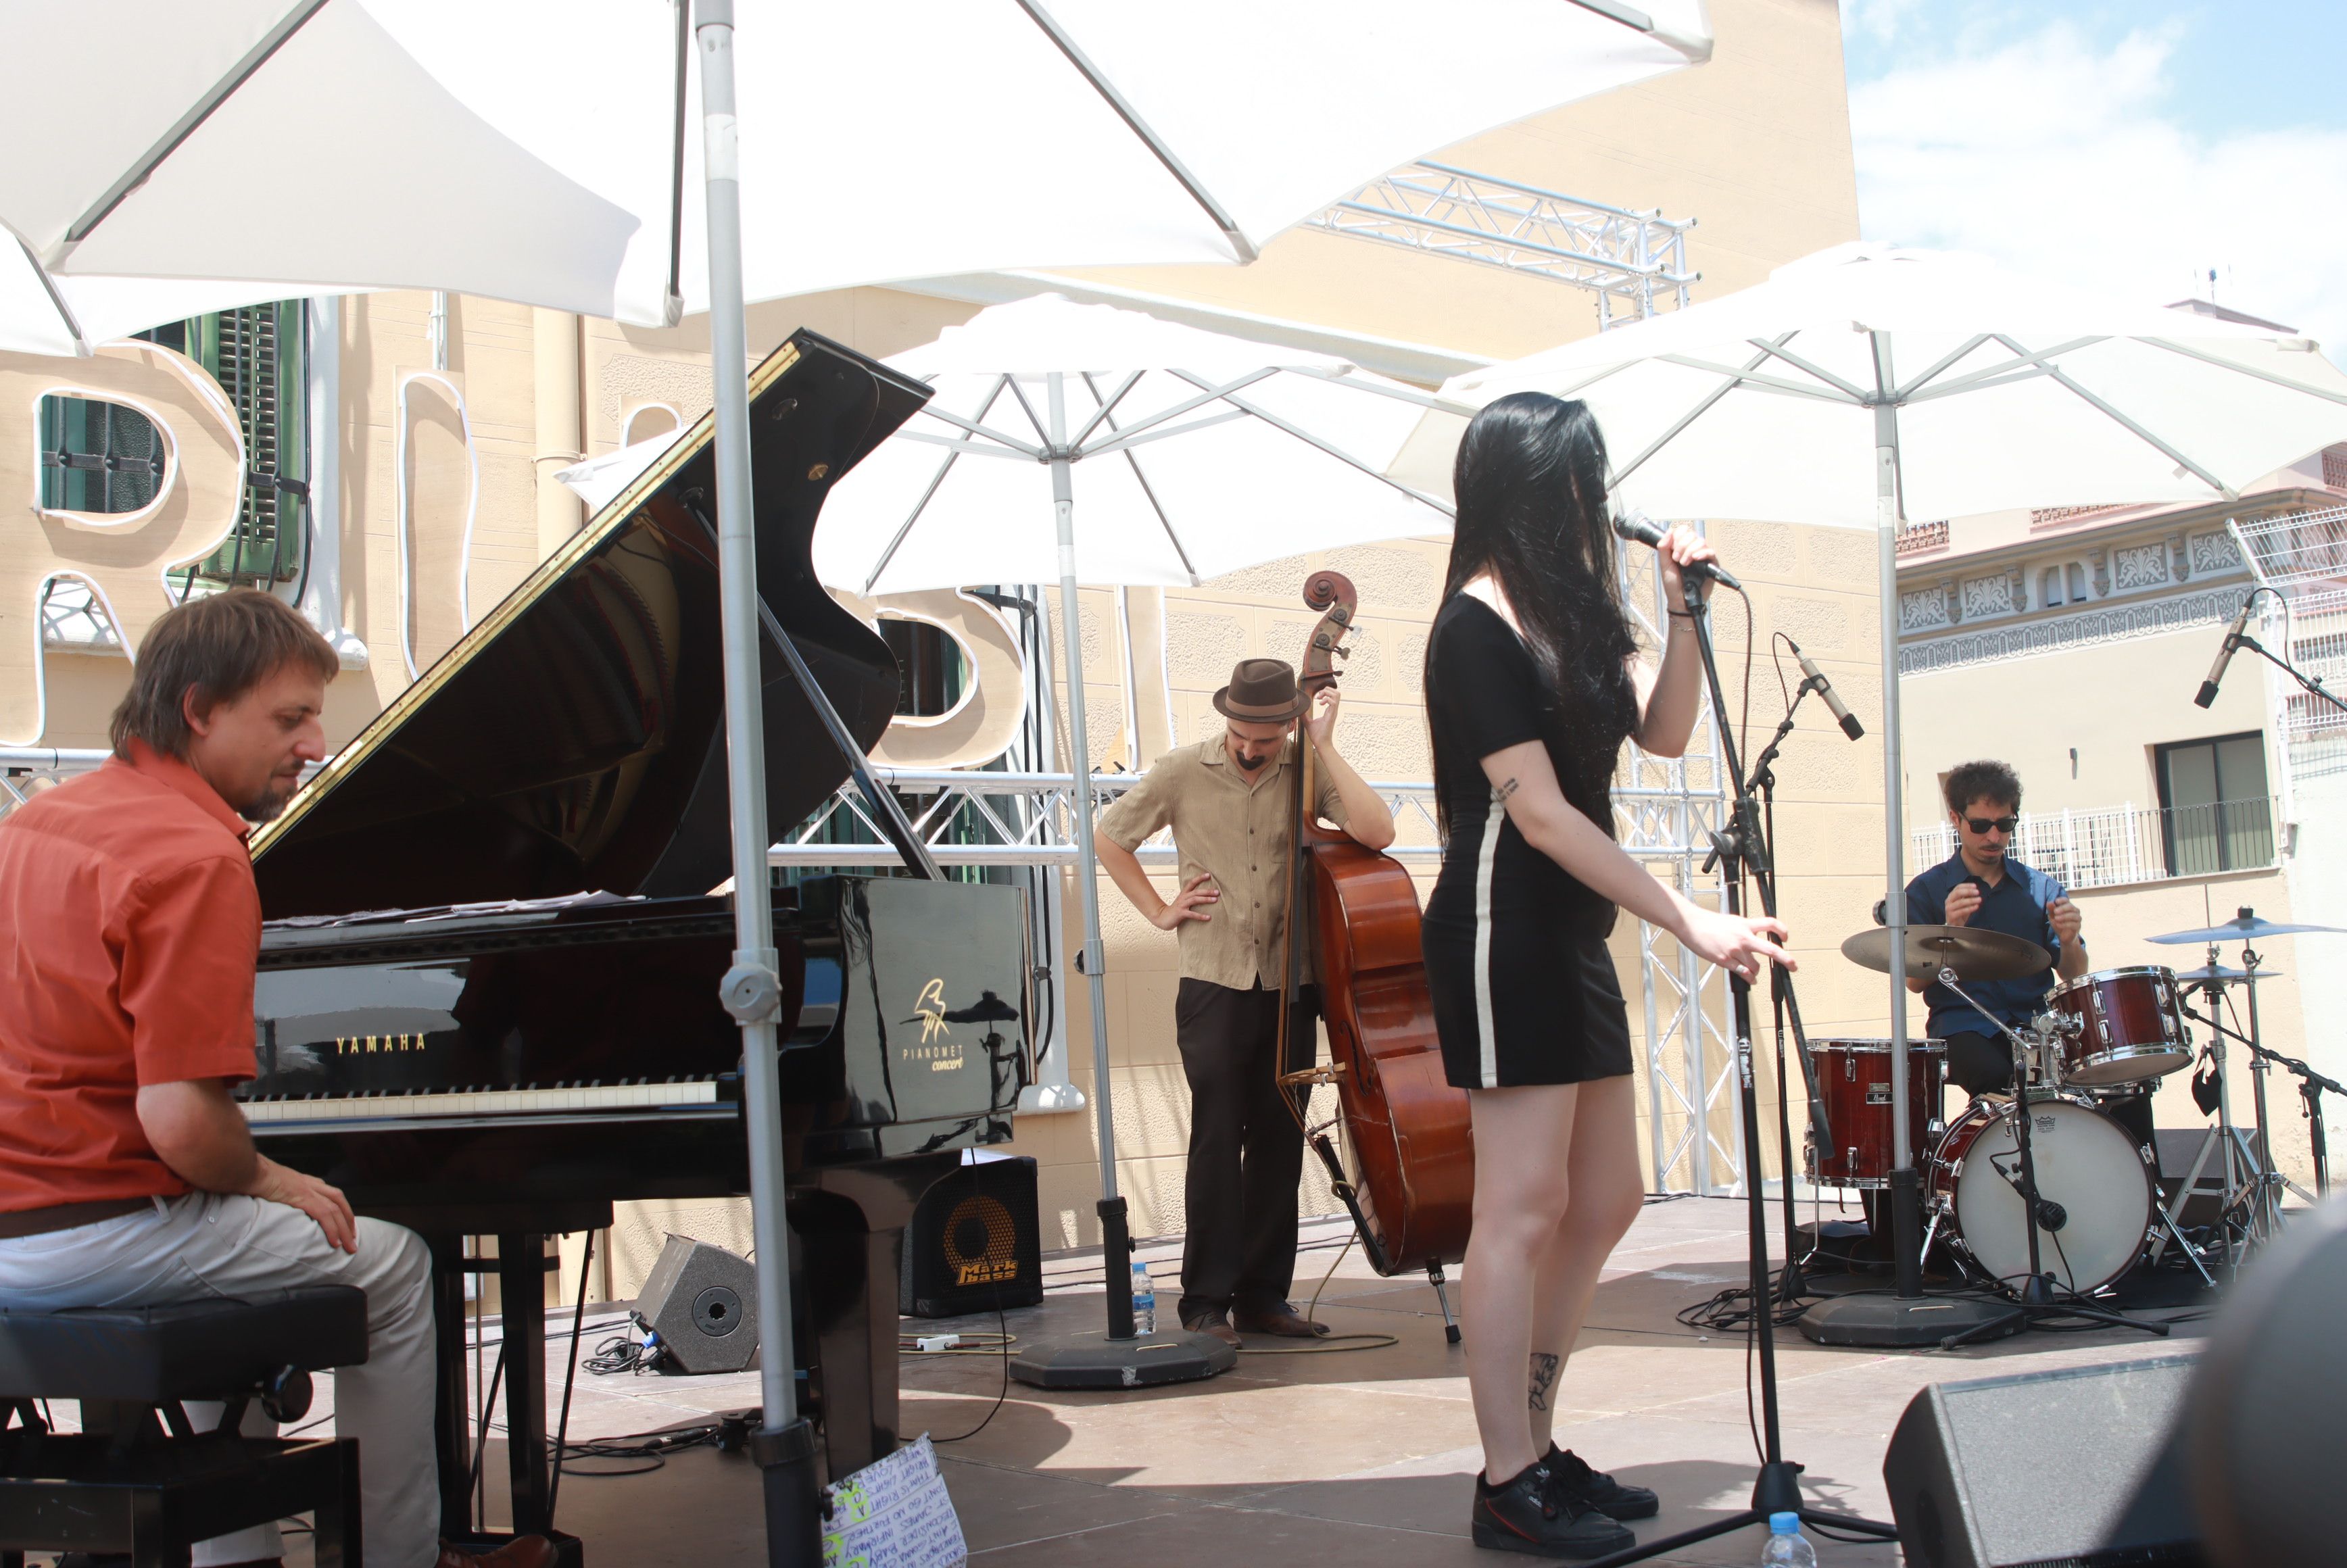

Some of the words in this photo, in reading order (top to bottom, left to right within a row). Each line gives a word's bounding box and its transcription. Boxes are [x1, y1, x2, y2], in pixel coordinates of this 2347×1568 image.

[336, 1031, 426, 1055] YAMAHA
[903, 1045, 962, 1060] PIANOMET
[932, 1057, 963, 1071] concert
[957, 1259, 1018, 1285] Mark
[965, 1271, 1016, 1283] bass
[895, 1444, 926, 1467] SWEET
[869, 1490, 900, 1512] RIGHT
[907, 1498, 922, 1511] GO
[857, 1504, 867, 1517] A
[892, 1506, 906, 1520] NO
[898, 1505, 934, 1532] JAMES
[869, 1541, 898, 1566] BABY
